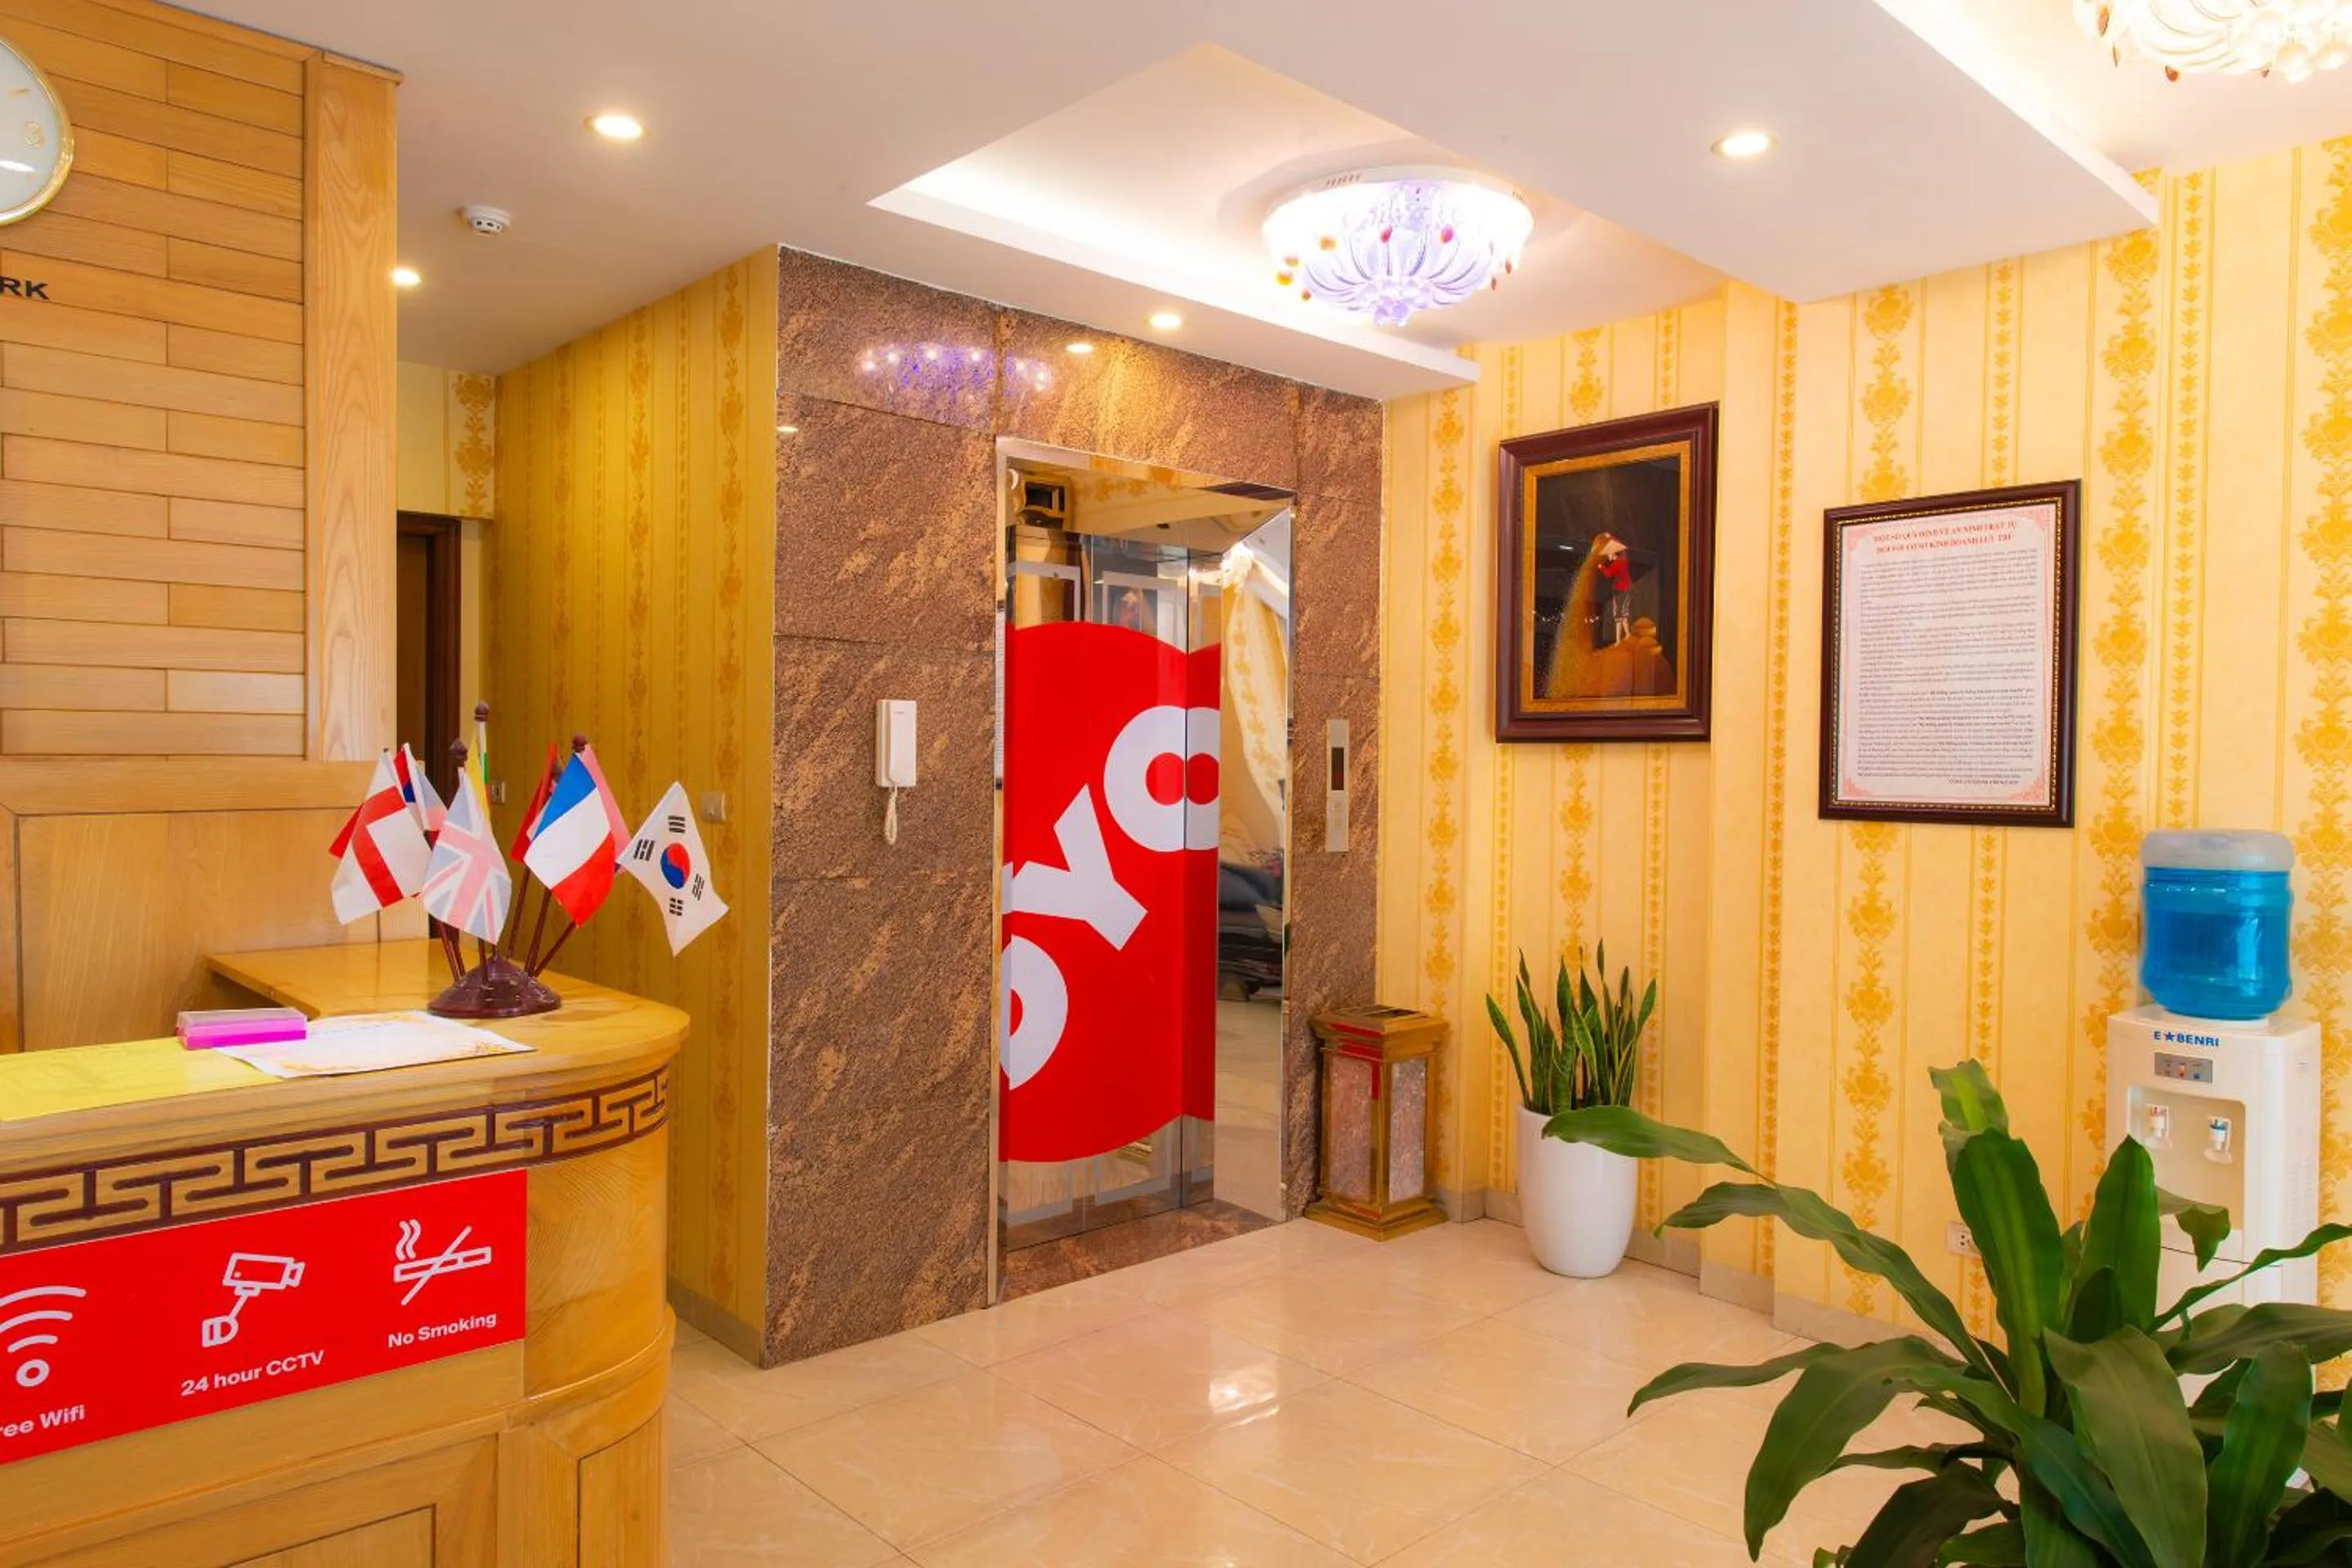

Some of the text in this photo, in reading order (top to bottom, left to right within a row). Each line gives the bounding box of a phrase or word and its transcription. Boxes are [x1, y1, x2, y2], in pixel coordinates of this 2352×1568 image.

[0, 275, 50, 301] RK
[388, 1313, 497, 1348] No Smoking
[181, 1350, 324, 1396] 24 hour CCTV
[0, 1404, 85, 1437] ee Wifi
